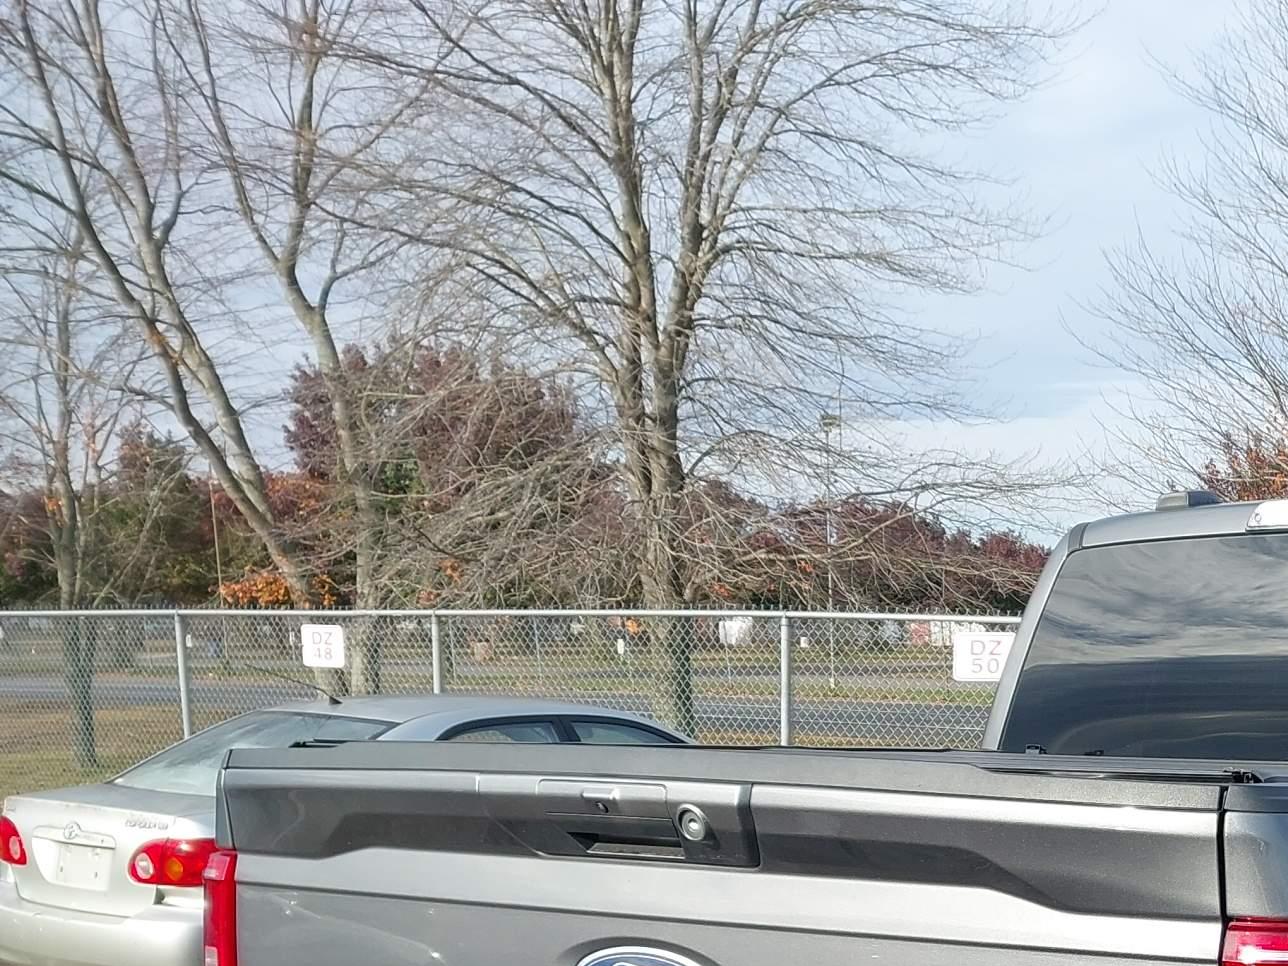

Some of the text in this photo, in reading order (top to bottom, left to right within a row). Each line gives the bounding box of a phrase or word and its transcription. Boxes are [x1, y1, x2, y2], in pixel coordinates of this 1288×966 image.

[312, 631, 333, 646] DZ
[970, 640, 1002, 656] DZ
[971, 658, 1000, 673] 50
